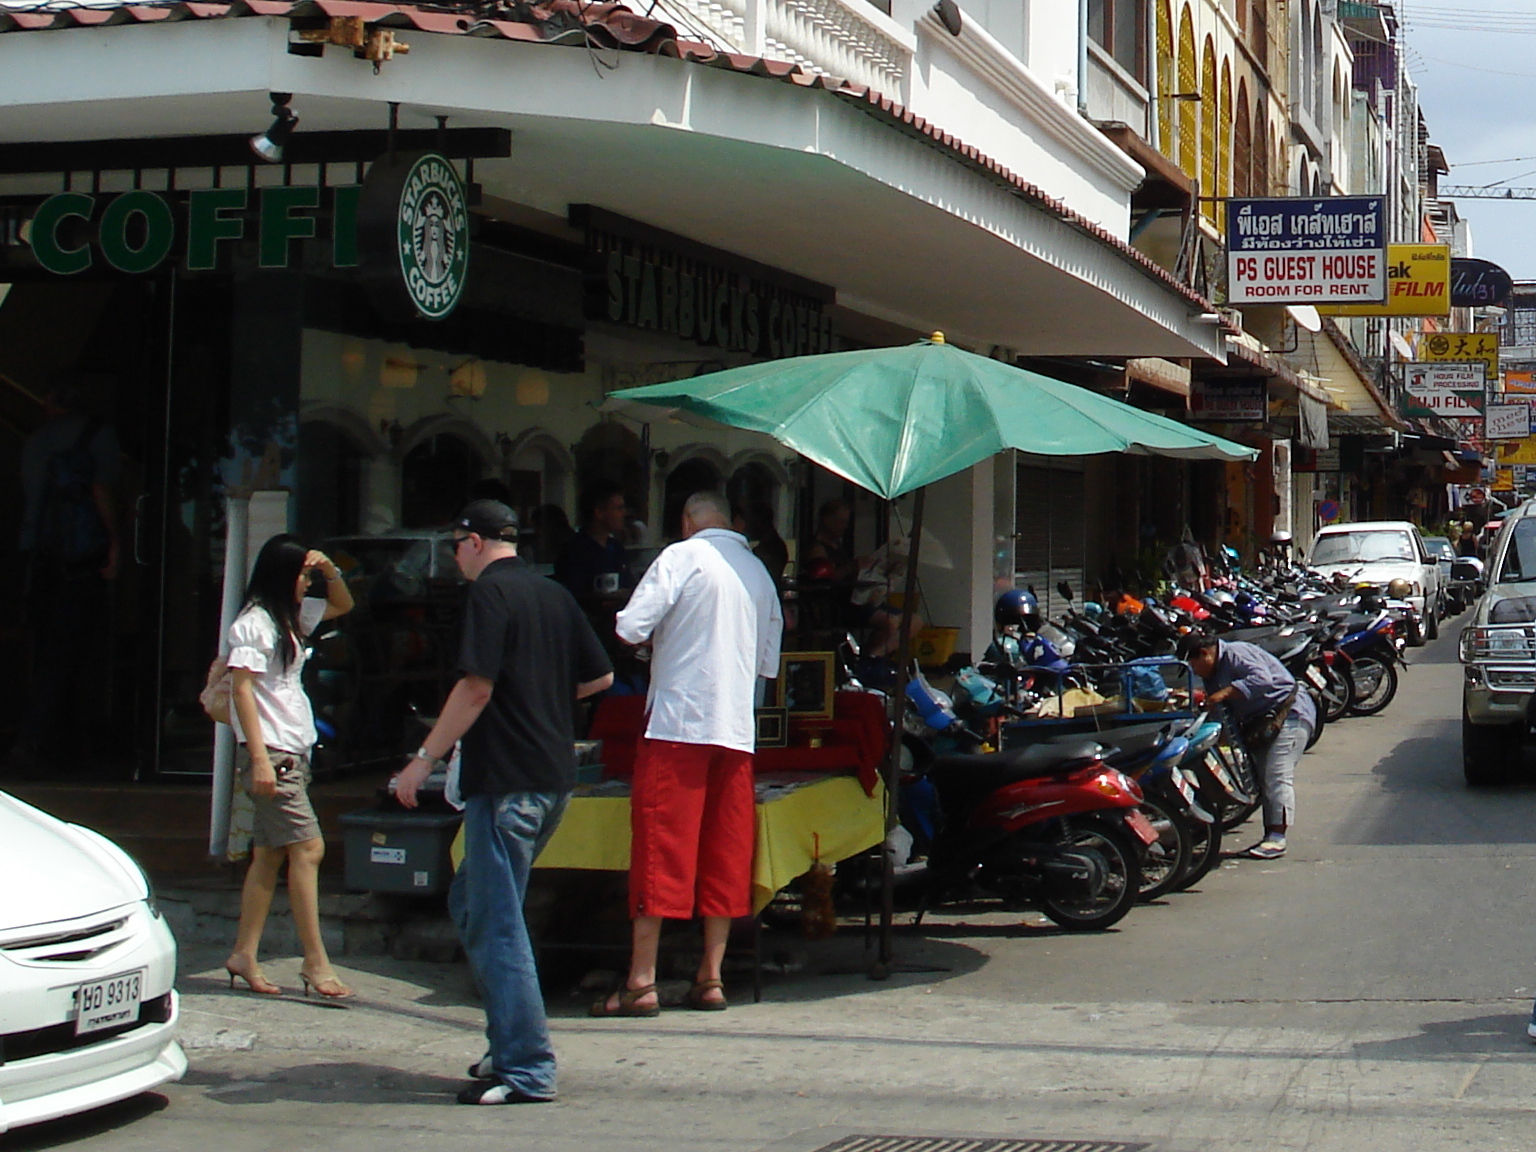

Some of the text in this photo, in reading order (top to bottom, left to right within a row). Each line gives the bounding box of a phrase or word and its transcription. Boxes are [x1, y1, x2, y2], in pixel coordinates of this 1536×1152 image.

[402, 162, 465, 228] STARBUCKS
[1237, 204, 1283, 235] พีเอส
[1236, 254, 1376, 281] PS GUEST HOUSE
[409, 267, 457, 309] COFFEE
[607, 250, 760, 354] STARBUCKS
[1245, 283, 1369, 297] ROOM FOR RENT
[1394, 281, 1445, 297] FILM
[1454, 338, 1495, 356] 大和
[1408, 396, 1482, 408] FUJI FILM
[107, 976, 139, 1006] 9313
